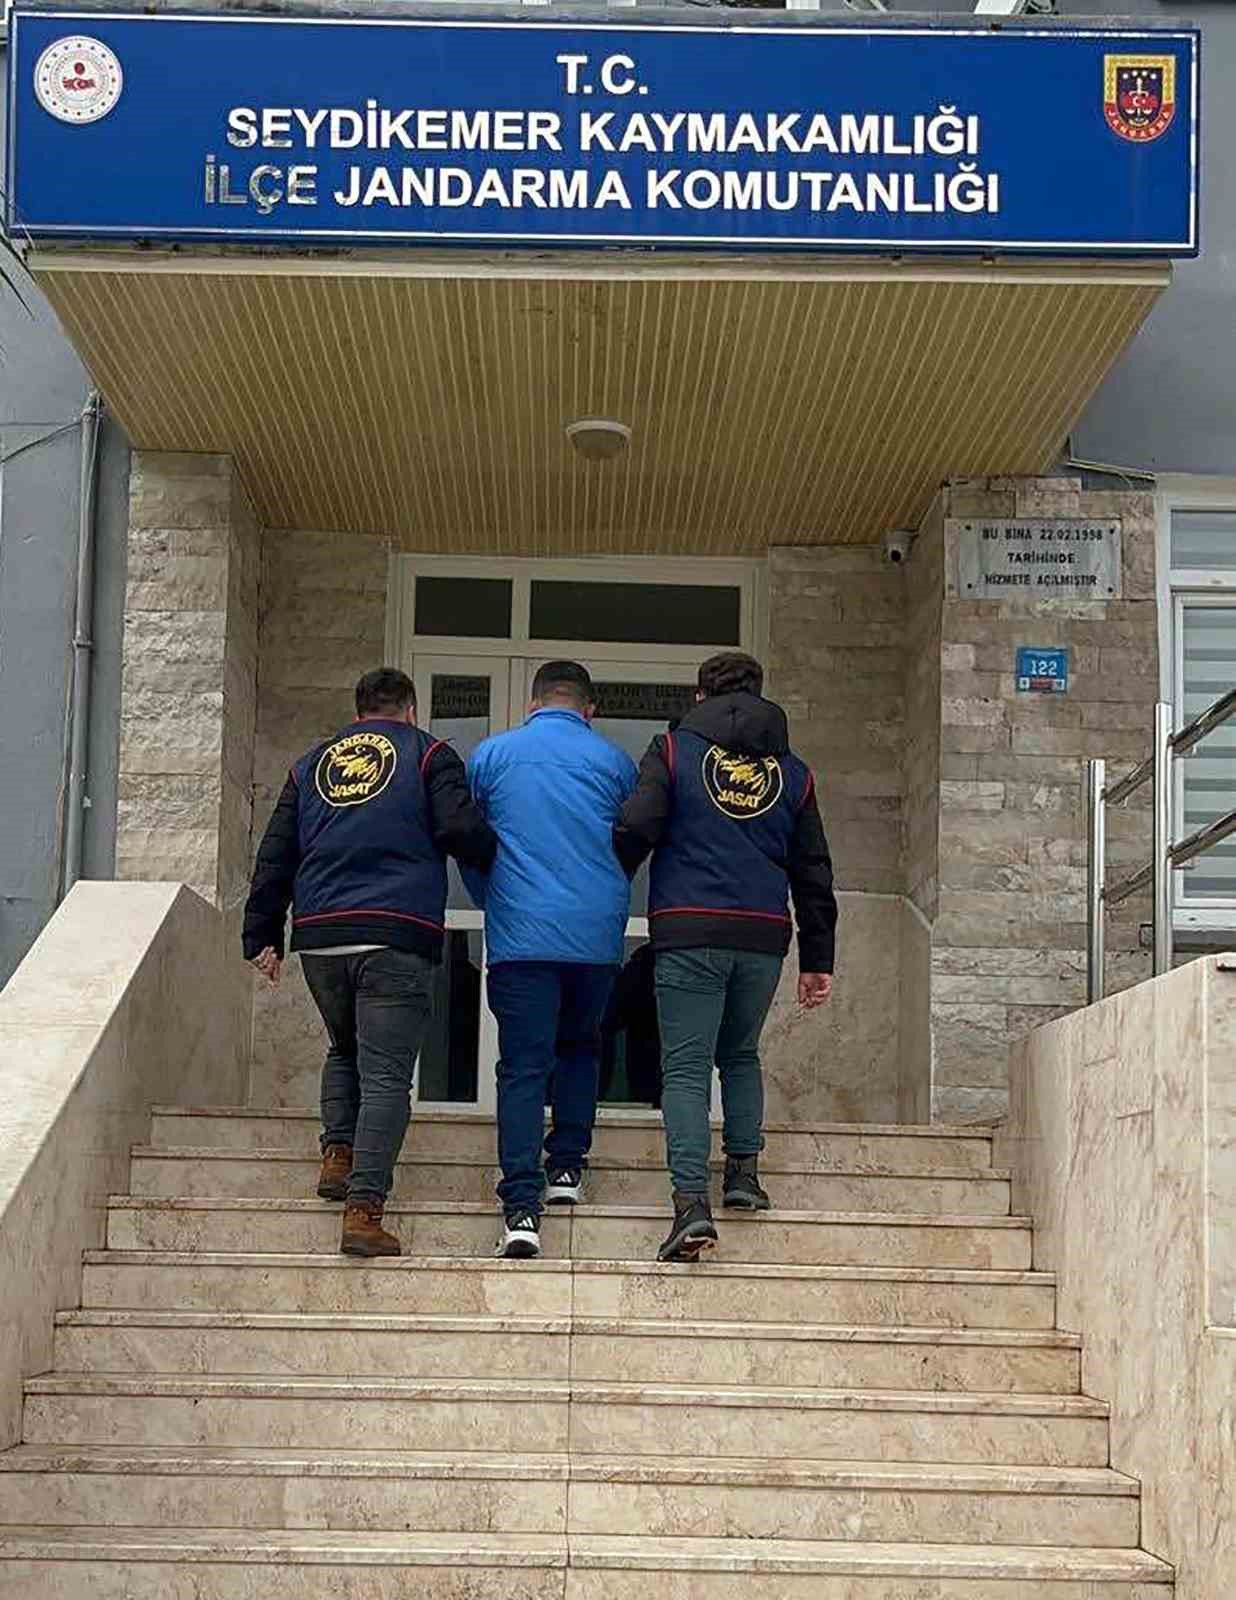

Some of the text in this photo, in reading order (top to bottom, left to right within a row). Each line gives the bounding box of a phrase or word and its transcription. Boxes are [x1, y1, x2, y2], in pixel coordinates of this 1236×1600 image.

[227, 100, 978, 155] SEYDİKEMER KAYMAKAMLIĞI
[206, 155, 998, 214] İLÇE JANDARMA KOMUTANLIĞI
[982, 528, 998, 540] BU
[1031, 660, 1057, 676] 122
[329, 783, 372, 798] JASAT
[717, 789, 761, 809] JASAT
